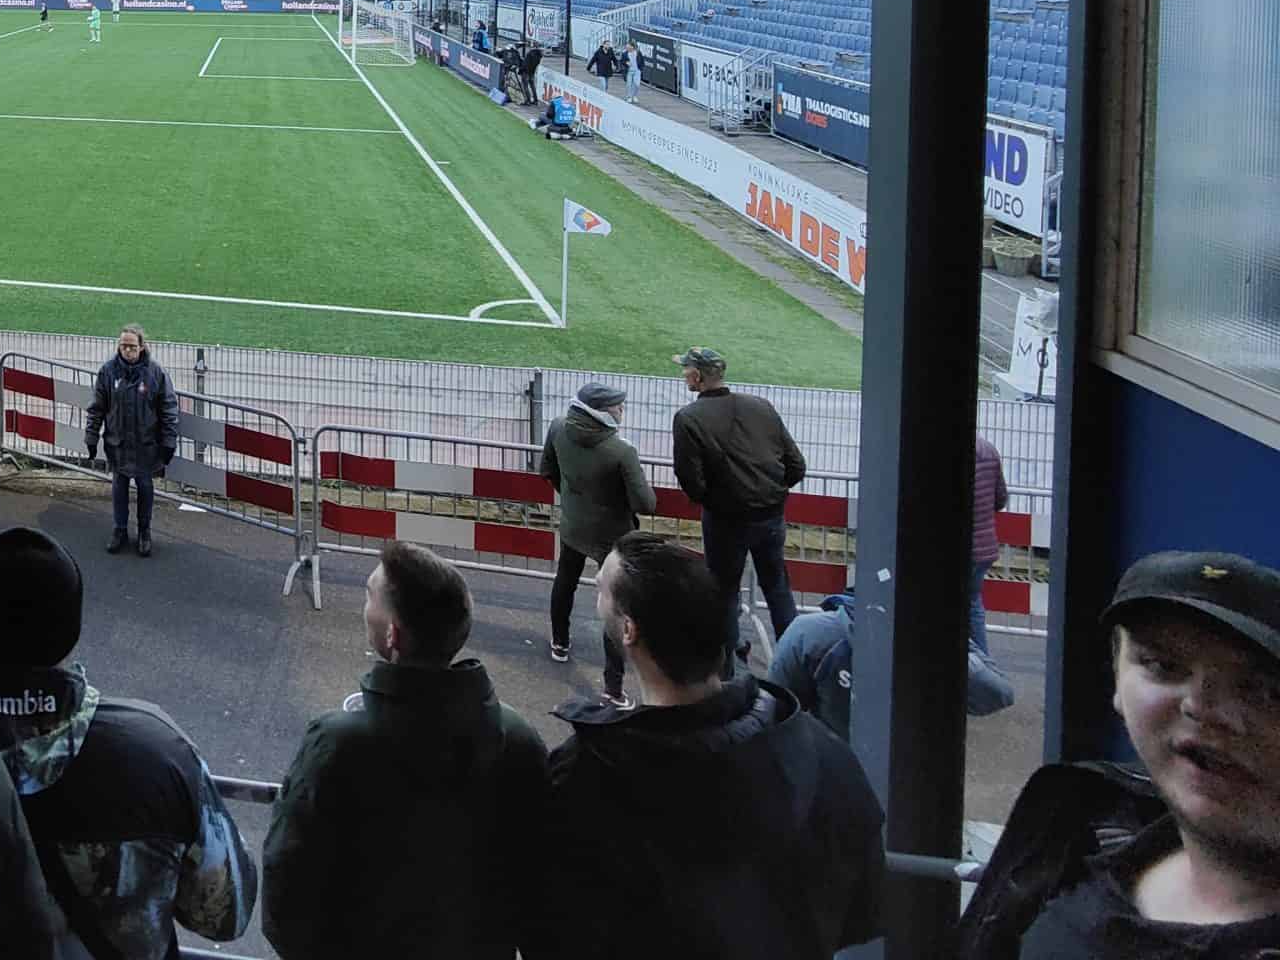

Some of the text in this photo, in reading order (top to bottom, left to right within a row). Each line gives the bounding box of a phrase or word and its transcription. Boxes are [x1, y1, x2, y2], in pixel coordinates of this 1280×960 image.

[282, 1, 340, 10] hollandcasino.n
[578, 98, 603, 130] WIT
[745, 180, 794, 242] JAN
[799, 209, 841, 273] DE
